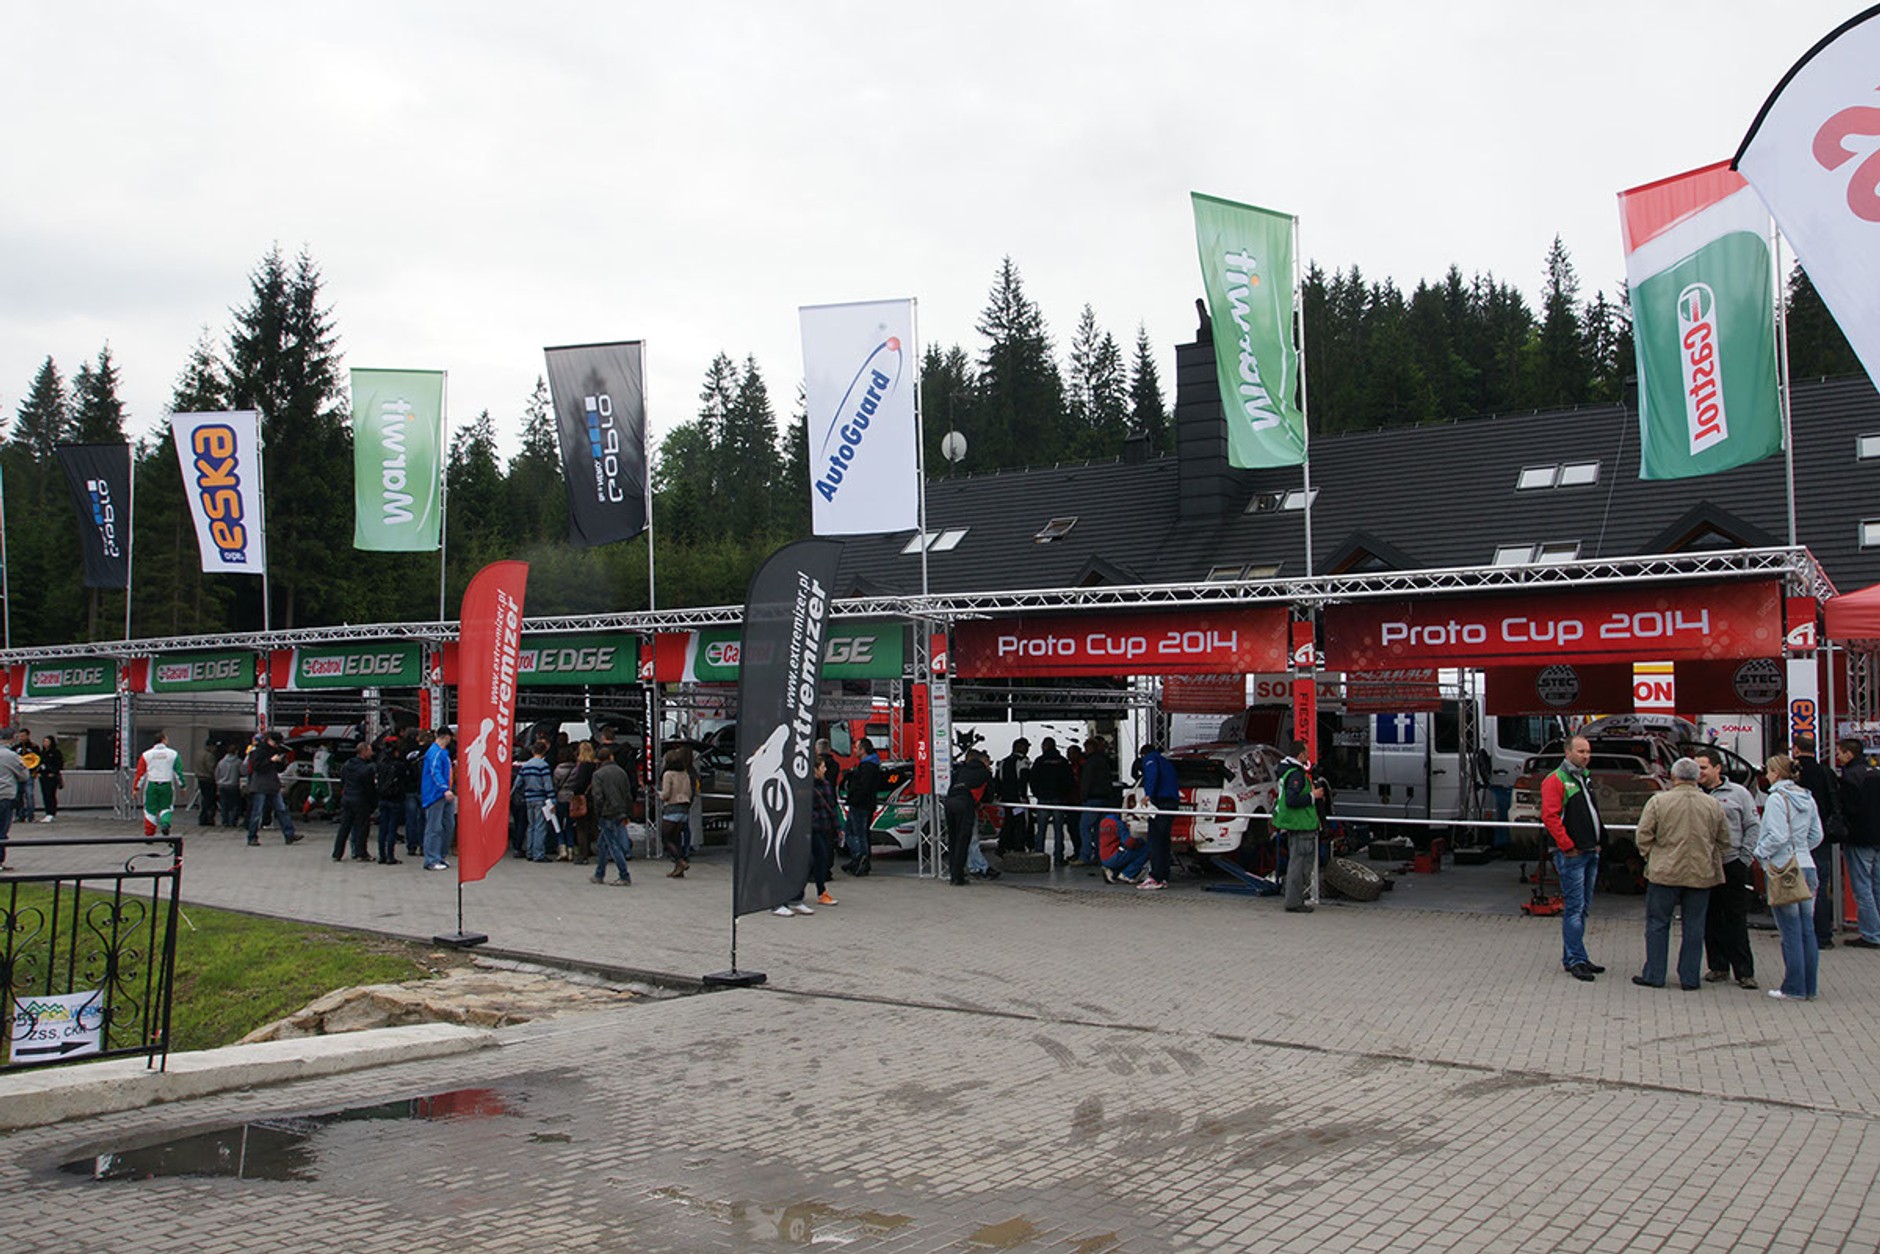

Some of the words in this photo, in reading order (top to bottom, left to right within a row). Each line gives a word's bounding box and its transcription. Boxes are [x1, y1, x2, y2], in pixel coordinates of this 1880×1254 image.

[815, 368, 891, 502] AutoGuard
[191, 424, 246, 550] eska
[786, 569, 809, 709] www.extremizer.pl
[1381, 620, 1487, 646] Proto
[1502, 617, 1584, 646] Cup
[1600, 609, 1711, 639] 2014
[490, 588, 507, 705] www.extremizer.pl
[823, 636, 877, 664] GE
[998, 634, 1075, 657] Proto
[1086, 633, 1147, 659] Cup
[1158, 630, 1238, 654] 2014
[192, 658, 242, 680] EDGE
[311, 657, 343, 675] Castrol
[344, 653, 406, 675] EDGE
[538, 647, 618, 672] EDGE
[63, 667, 104, 685] EDGE
[496, 595, 519, 763] extremizer
[792, 579, 827, 779] extremizer
[1257, 681, 1336, 698] SOX
[1736, 673, 1780, 685] STEC
[1633, 681, 1673, 702] ON
[1721, 725, 1753, 733] SONAX
